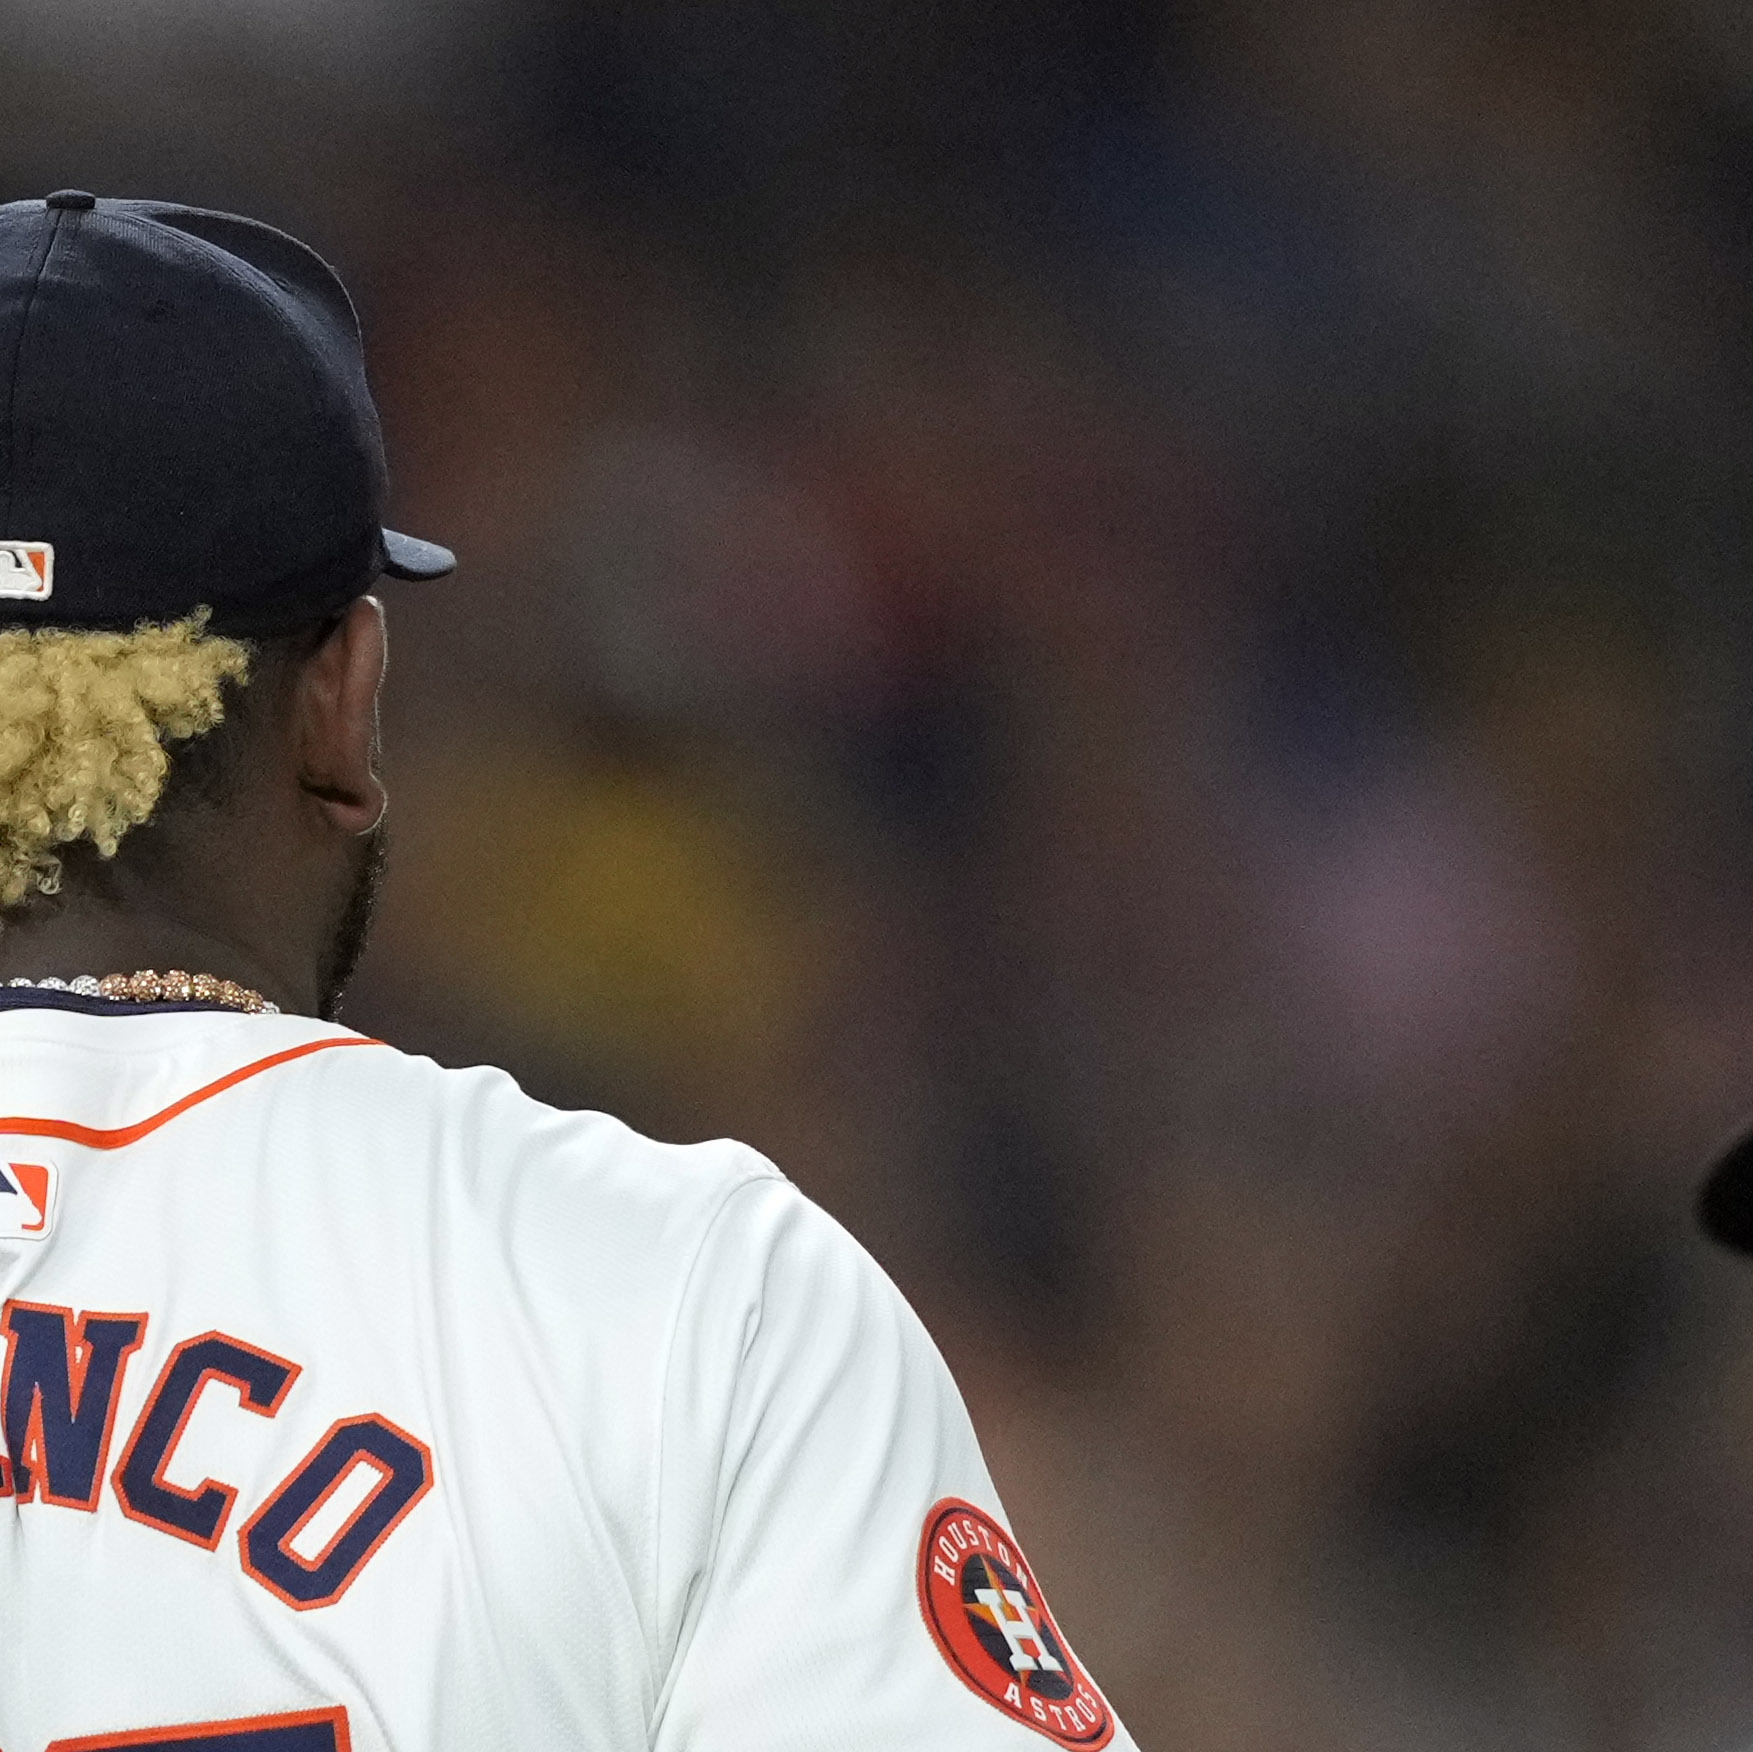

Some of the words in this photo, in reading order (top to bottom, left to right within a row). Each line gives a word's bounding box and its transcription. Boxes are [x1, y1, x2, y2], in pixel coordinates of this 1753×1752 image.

[933, 1519, 1028, 1586] HOUSTON
[974, 1588, 1065, 1672] H
[1004, 1682, 1098, 1732] ASTROS
